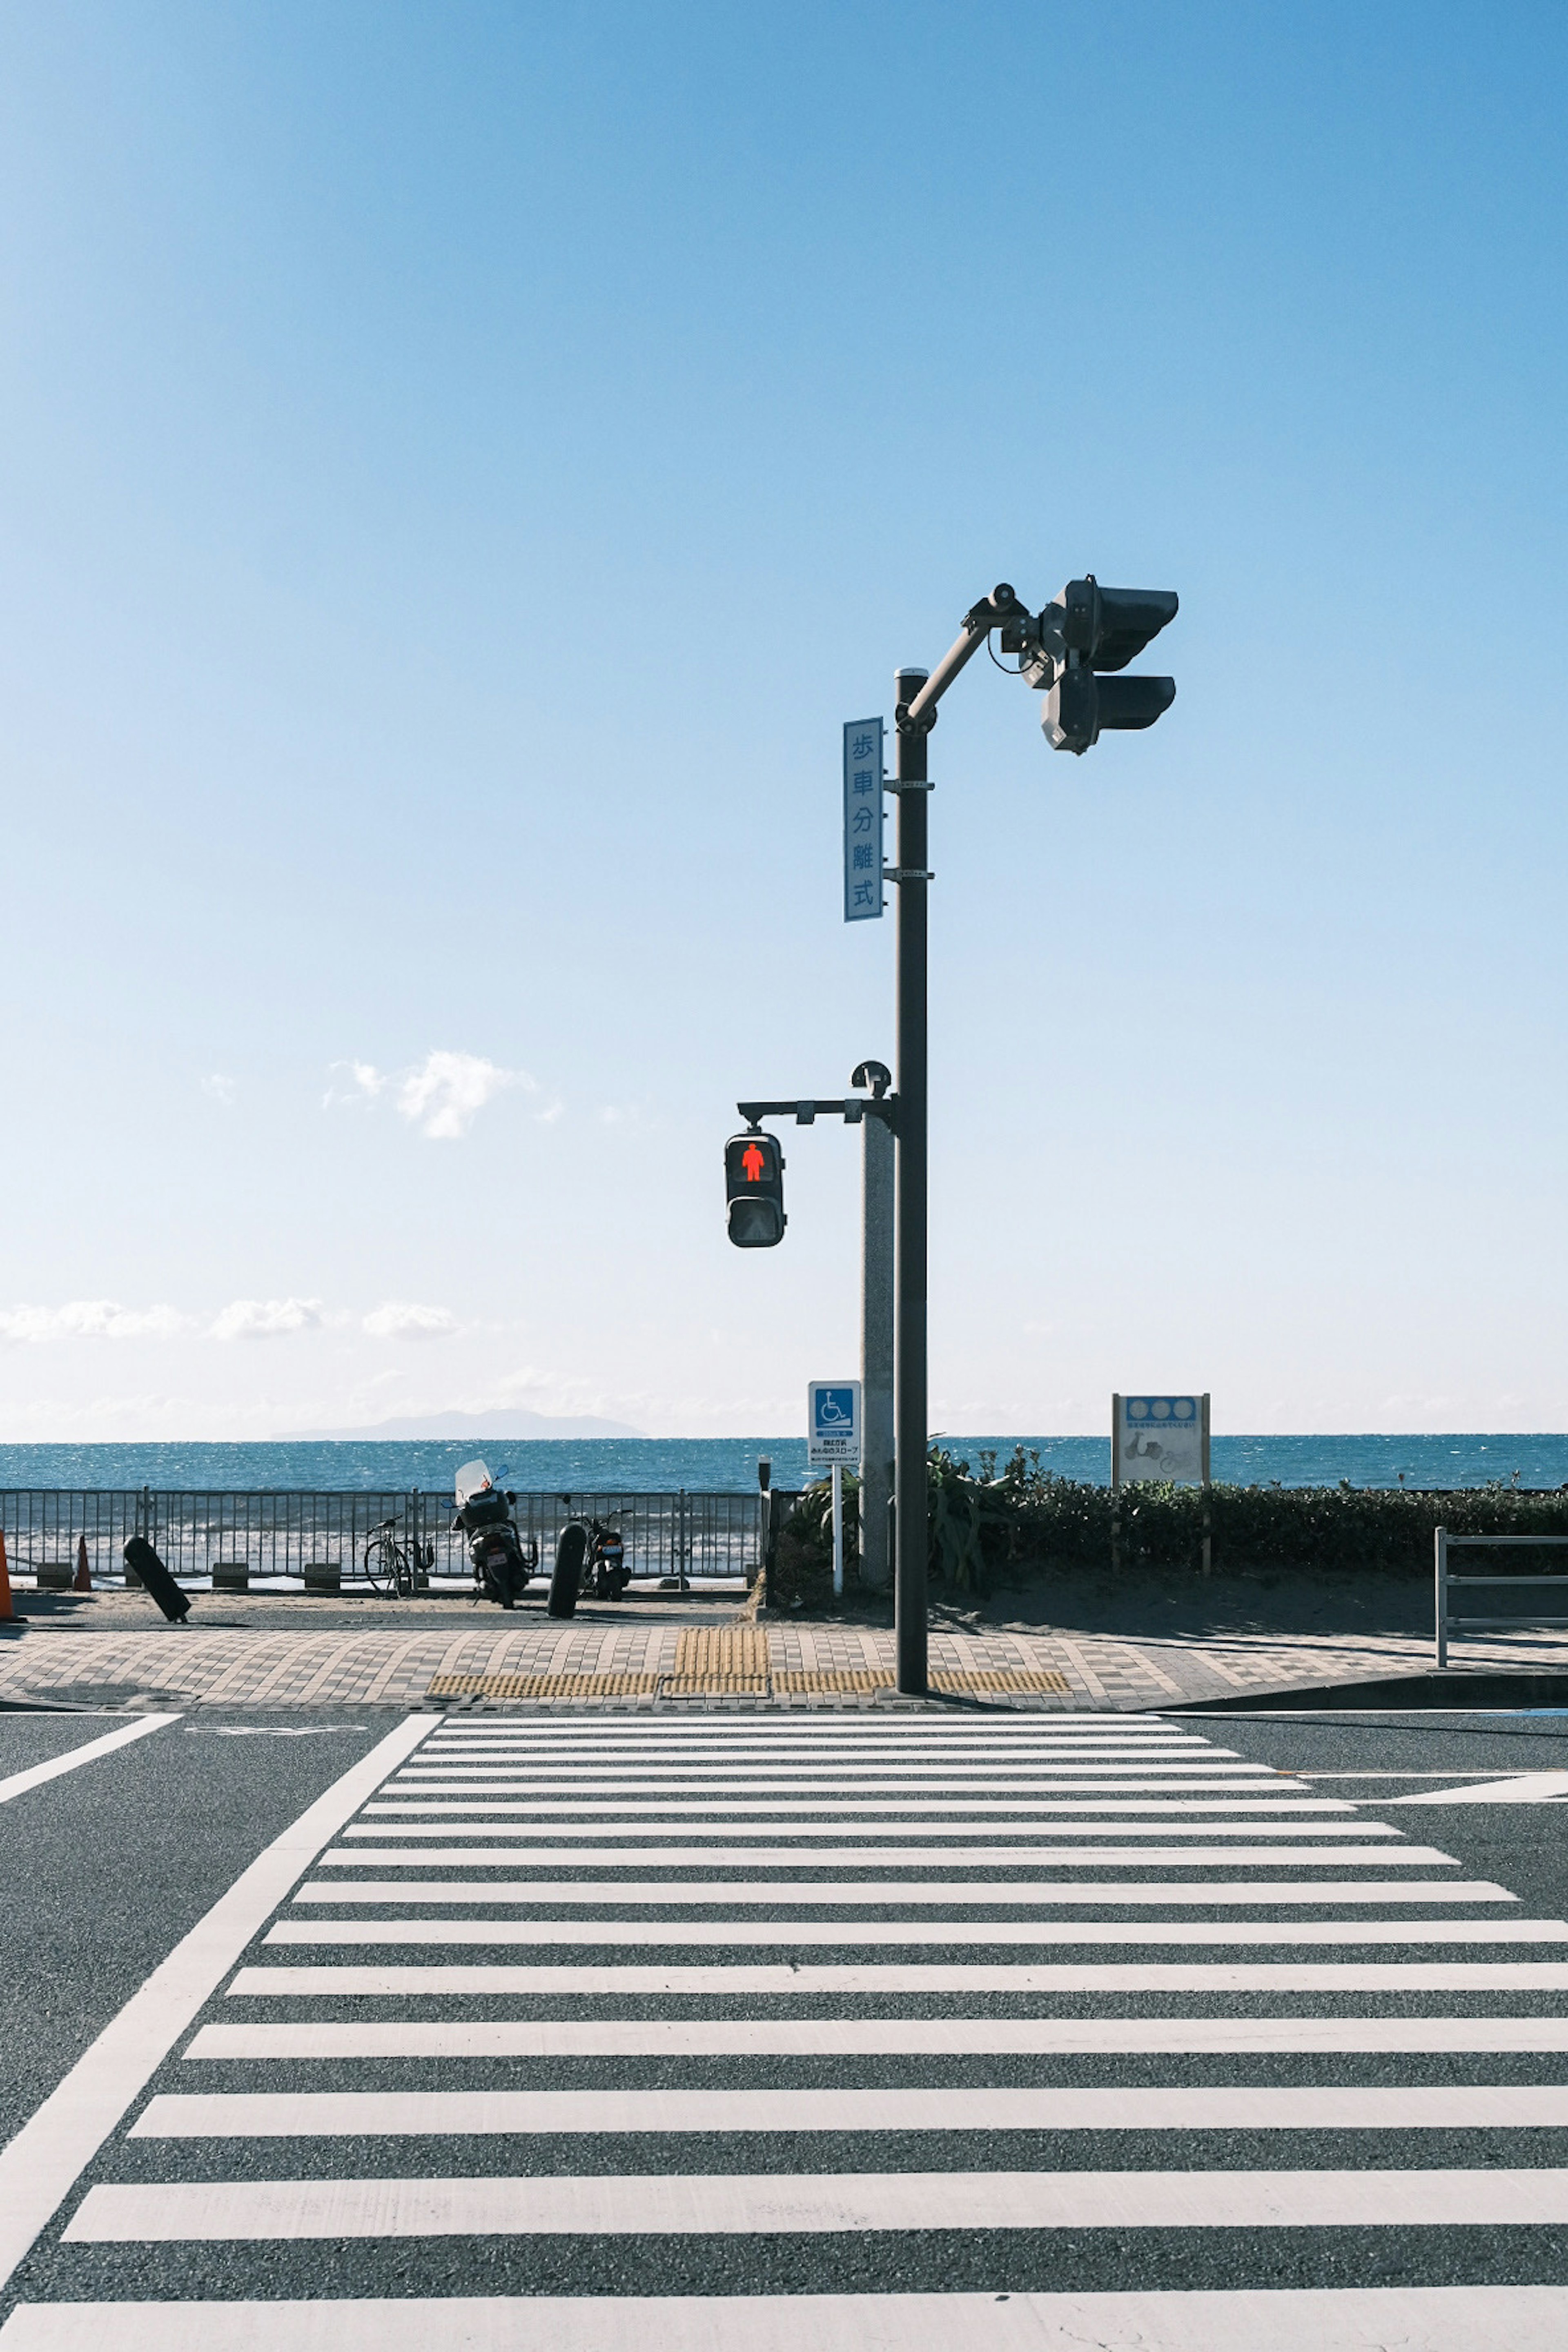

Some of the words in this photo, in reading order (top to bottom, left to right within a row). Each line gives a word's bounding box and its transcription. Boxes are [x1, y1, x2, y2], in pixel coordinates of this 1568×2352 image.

[852, 733, 874, 906] 歩車分離式
